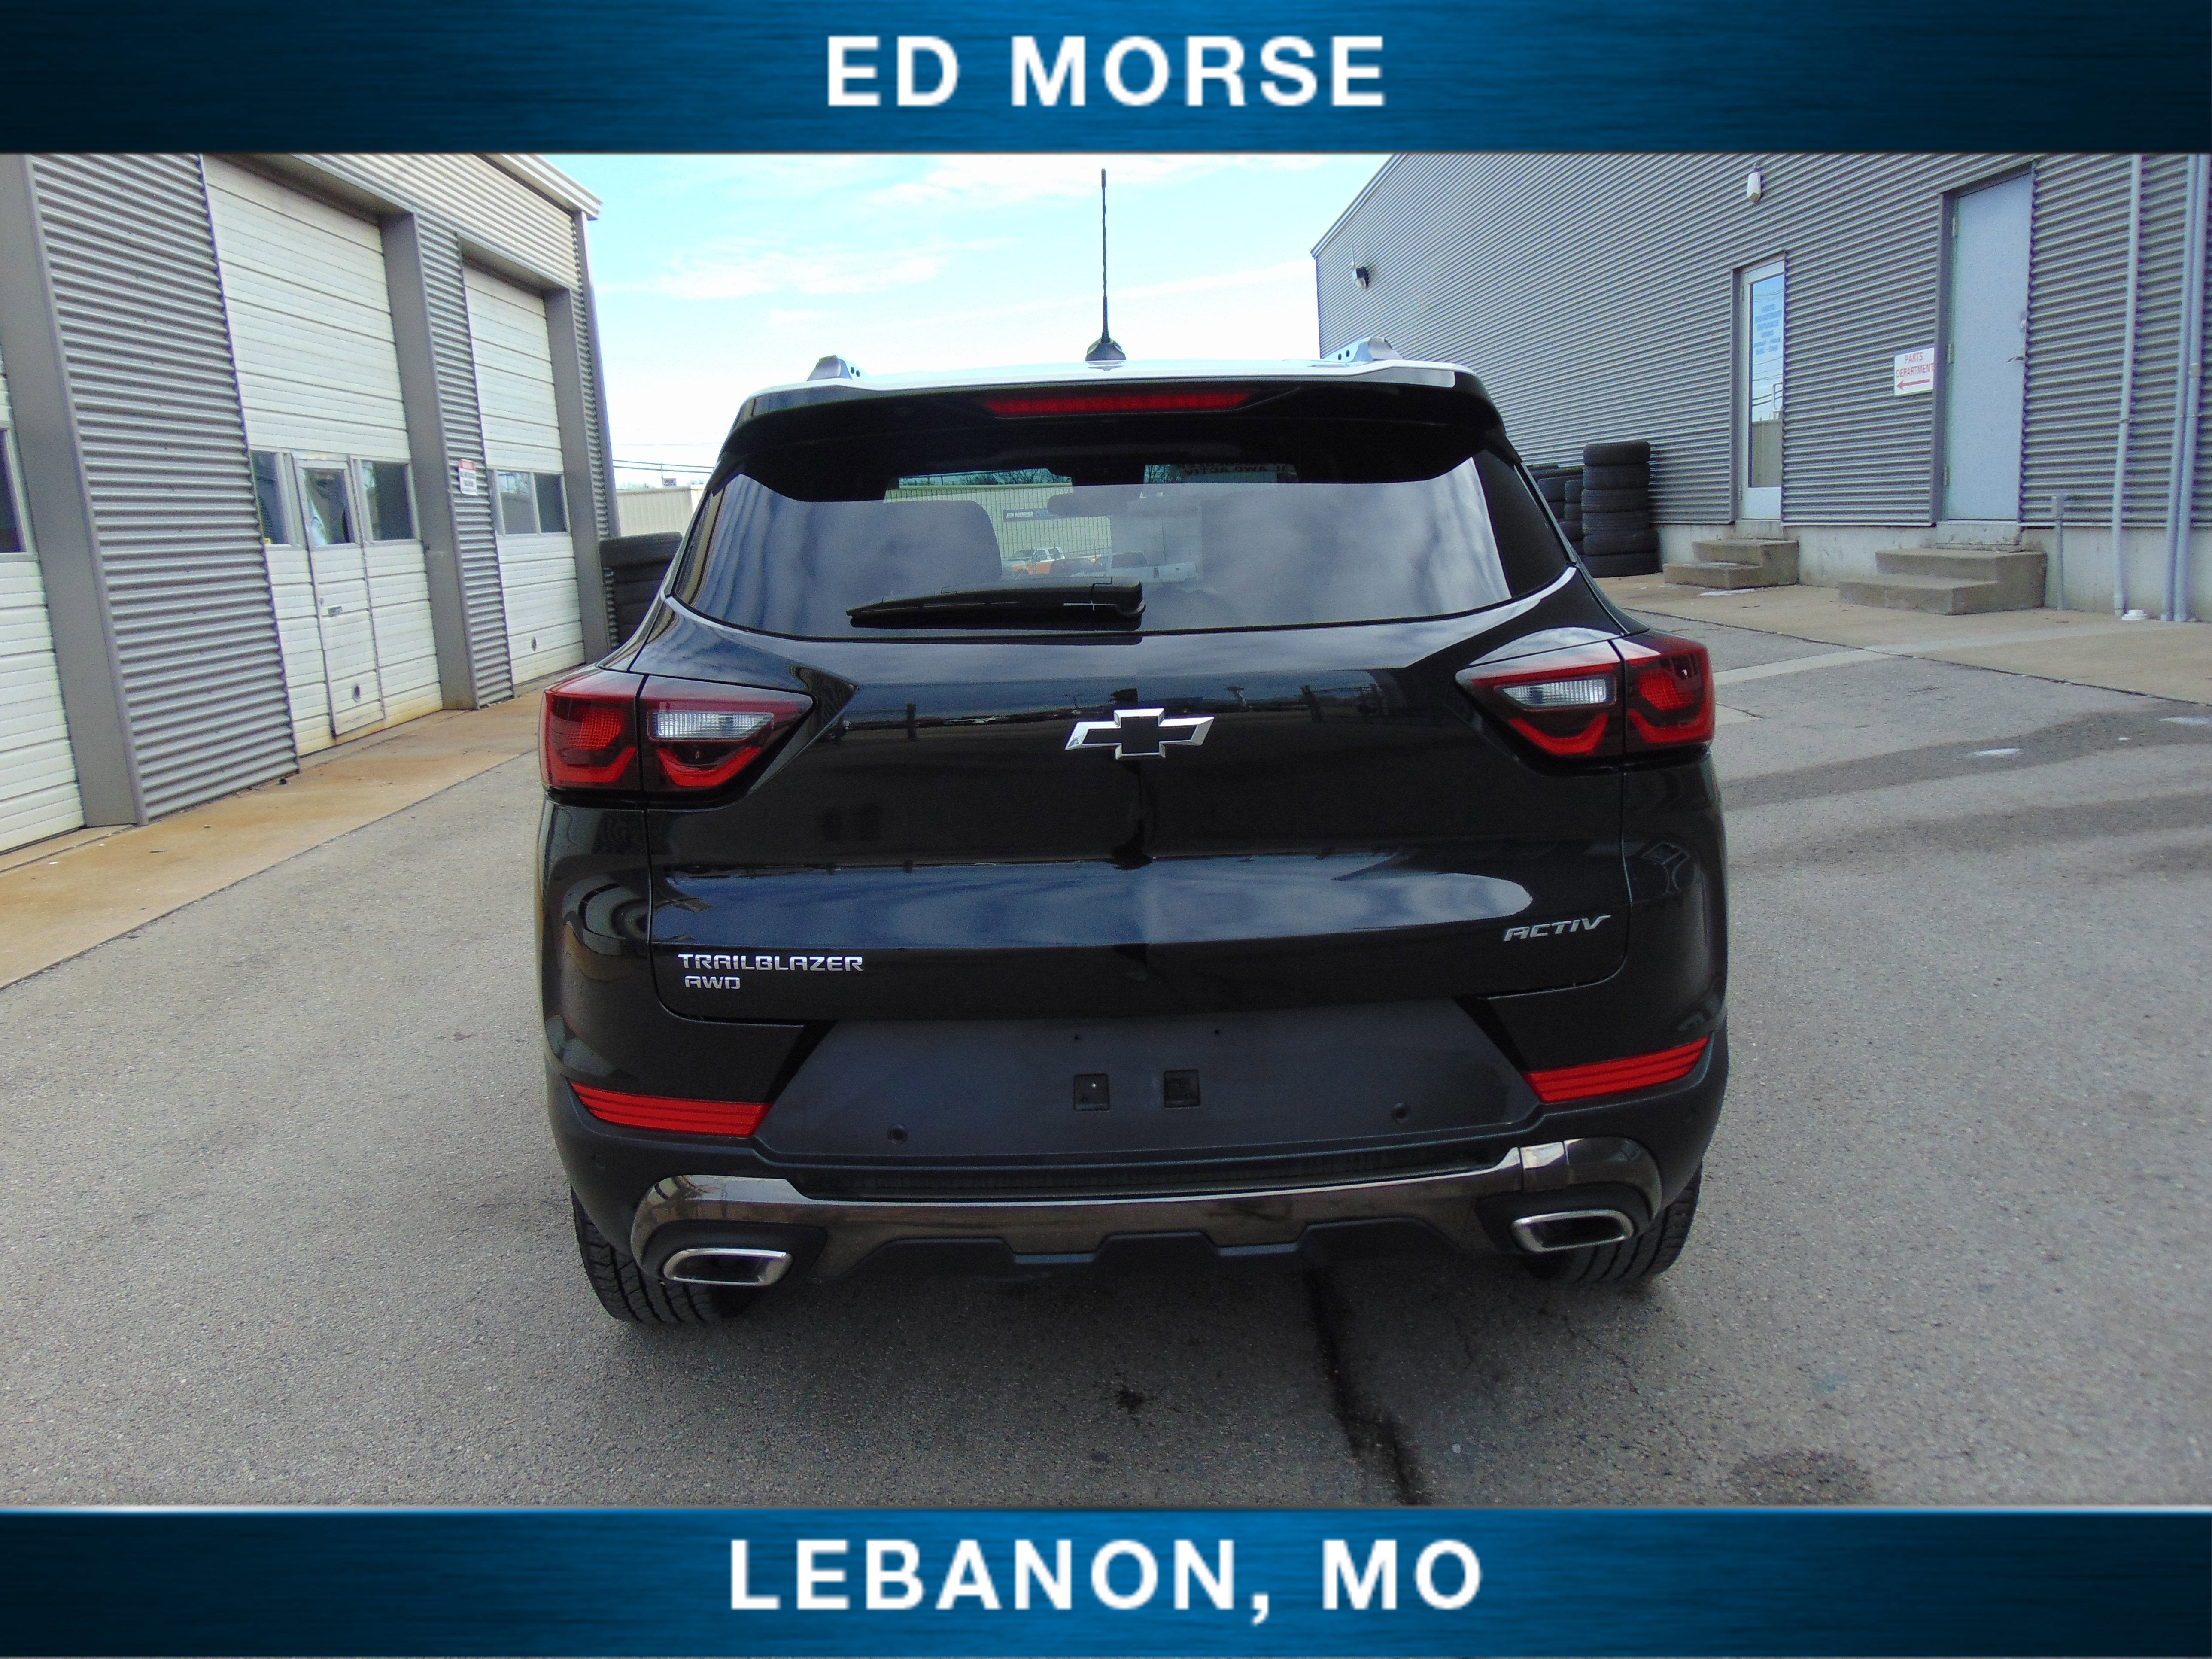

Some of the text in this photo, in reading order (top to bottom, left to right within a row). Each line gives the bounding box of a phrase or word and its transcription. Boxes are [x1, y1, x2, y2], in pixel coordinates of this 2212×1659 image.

[1905, 352, 1923, 363] PARTS
[1896, 362, 1934, 378] DEPARTMENT
[1503, 915, 1611, 942] ACTIV
[677, 953, 864, 972] TRAILBLAZER
[684, 975, 741, 990] AWD
